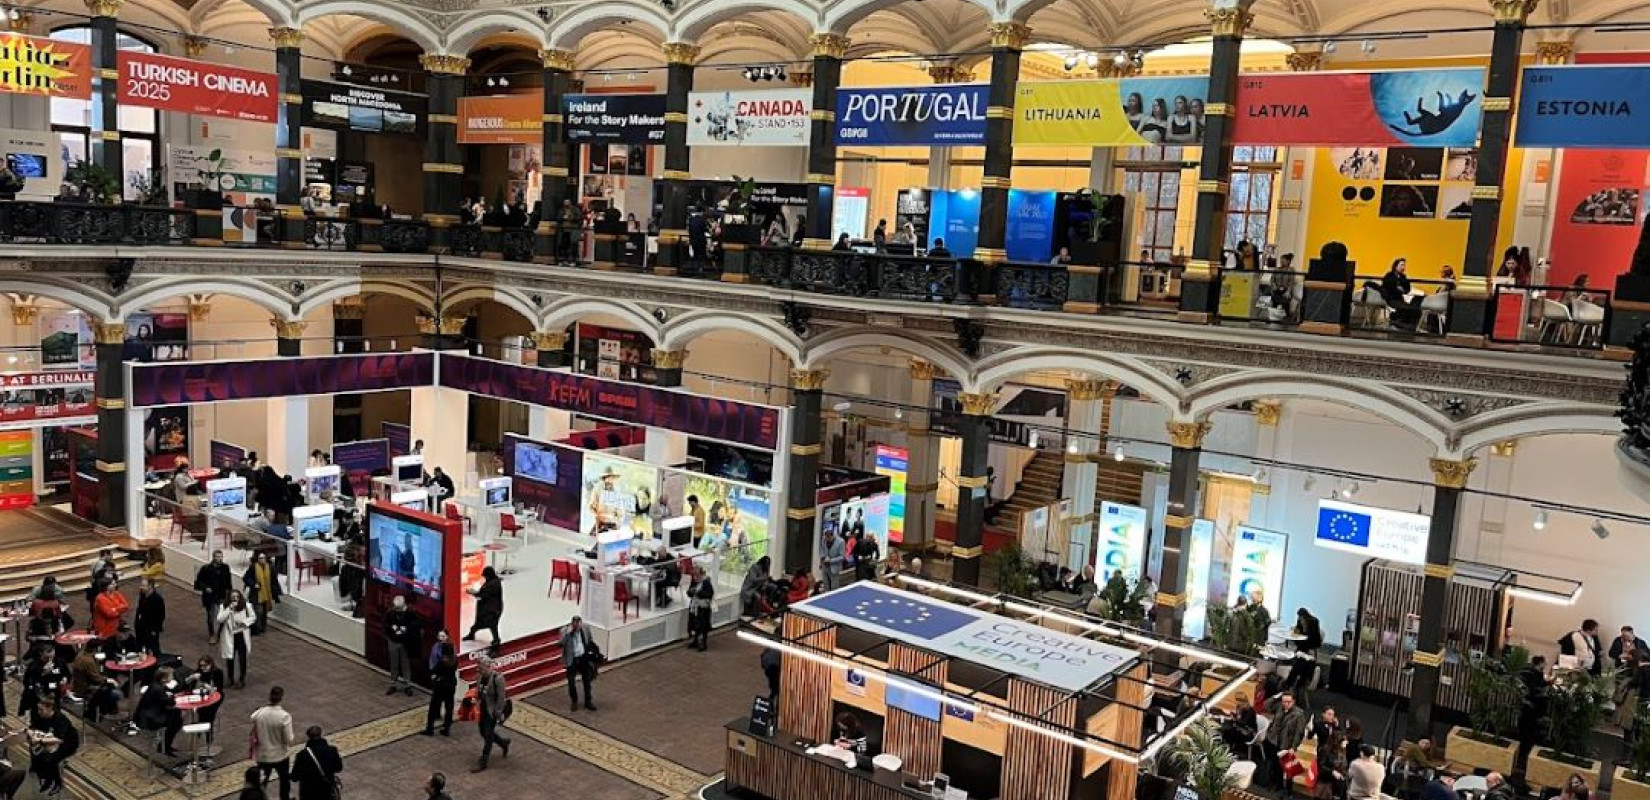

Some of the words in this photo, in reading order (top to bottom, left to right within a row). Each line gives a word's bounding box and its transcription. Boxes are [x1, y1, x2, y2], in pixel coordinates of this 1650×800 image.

[127, 61, 199, 87] TURKISH
[203, 73, 269, 98] CINEMA
[127, 80, 171, 101] 2025
[349, 89, 385, 101] DISCOVER
[330, 93, 357, 104] NORTH
[358, 98, 402, 111] MACEDONIA
[569, 101, 607, 112] Ireland
[841, 93, 986, 122] PORTUGAL
[1537, 101, 1631, 115] ESTONIA
[1025, 108, 1101, 121] LITHUANIA
[1249, 104, 1309, 118] LATVIA
[568, 115, 582, 125] For
[584, 115, 600, 125] the
[601, 115, 627, 127] Story
[629, 115, 666, 126] Makers
[11, 376, 25, 384] AT
[32, 371, 94, 384] BERLINALE
[973, 630, 1087, 667] Europe
[992, 622, 1124, 662] Creative
[953, 640, 1041, 672] MEDIA
